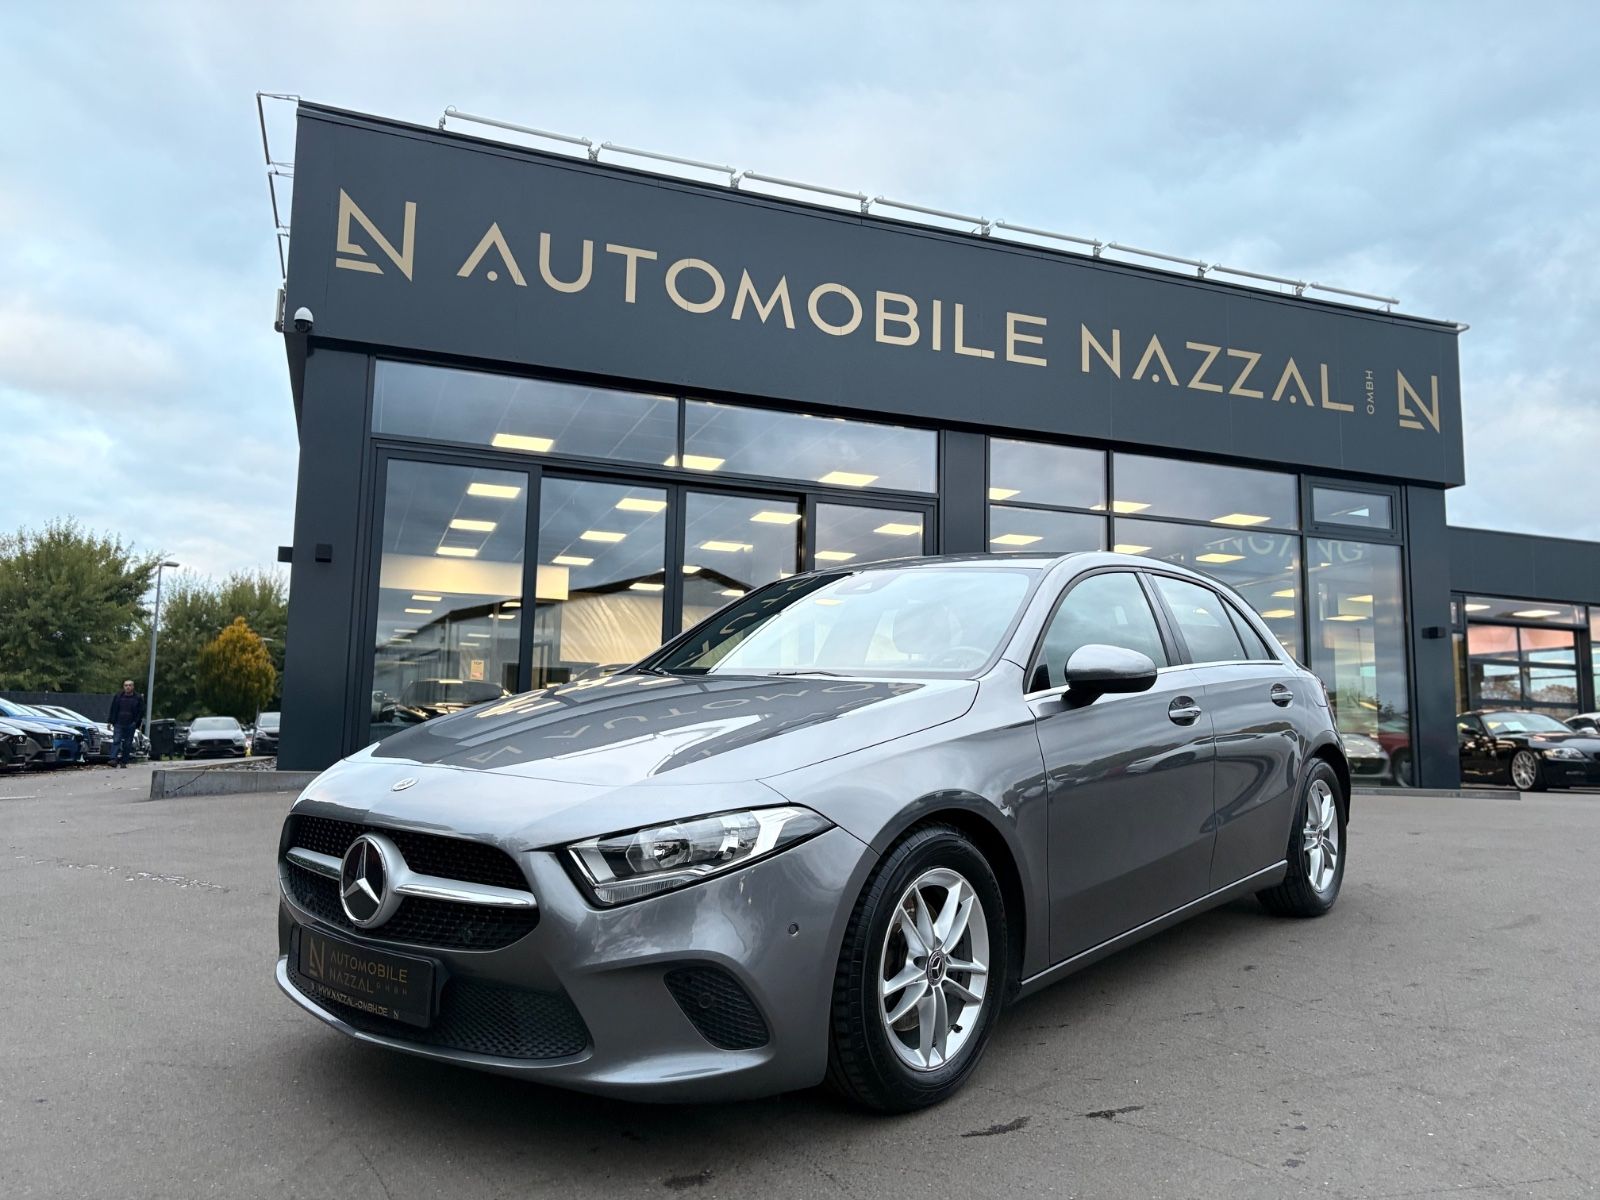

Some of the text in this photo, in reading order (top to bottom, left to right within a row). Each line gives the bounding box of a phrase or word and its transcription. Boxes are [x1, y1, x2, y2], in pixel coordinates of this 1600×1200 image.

[456, 221, 1048, 368] AUTOMOBILE
[1080, 322, 1355, 413] NAZZAL
[1365, 369, 1375, 415] GMBH
[329, 967, 375, 994] NAZZAL
[330, 951, 408, 984] AUTOMOBILE
